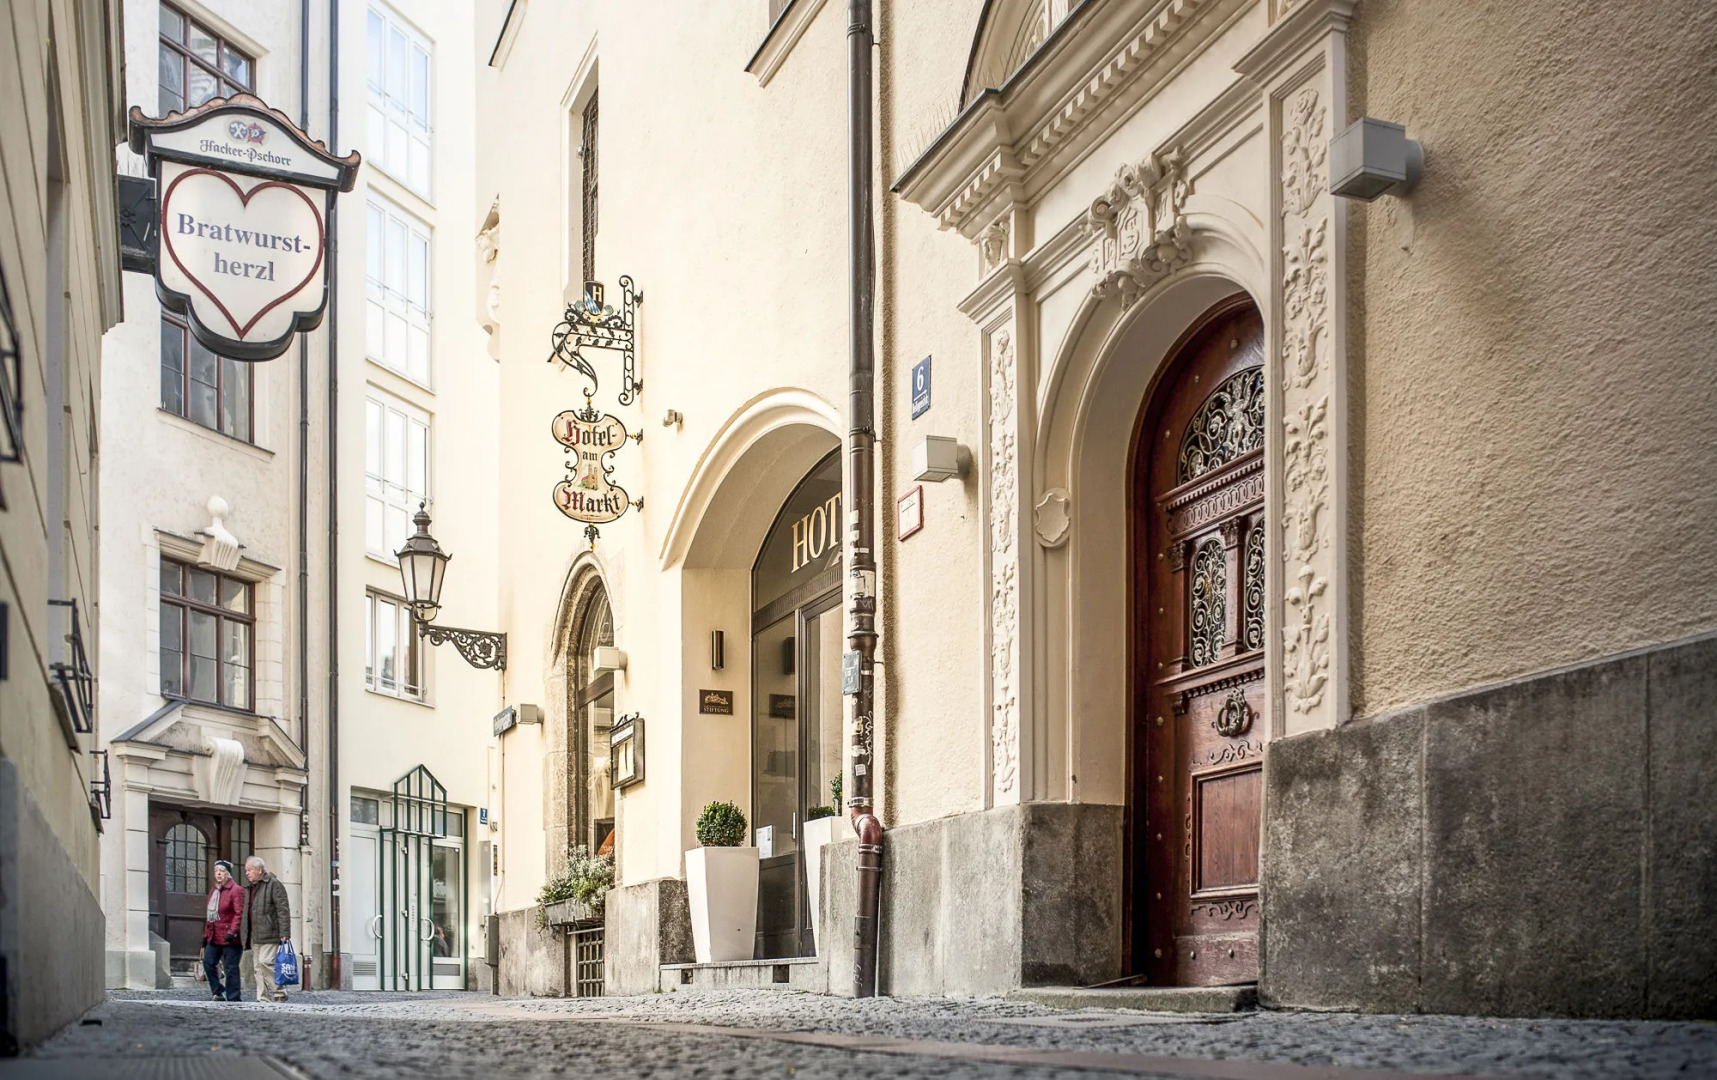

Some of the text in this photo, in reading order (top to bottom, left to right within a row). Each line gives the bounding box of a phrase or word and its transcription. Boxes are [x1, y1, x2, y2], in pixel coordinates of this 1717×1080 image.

[200, 139, 292, 166] Hacker-Pschorr
[177, 212, 311, 254] Bratwurst-
[213, 251, 275, 282] herzl
[592, 285, 602, 302] H
[916, 365, 924, 391] 6
[582, 450, 598, 462] am
[561, 486, 620, 515] Markt
